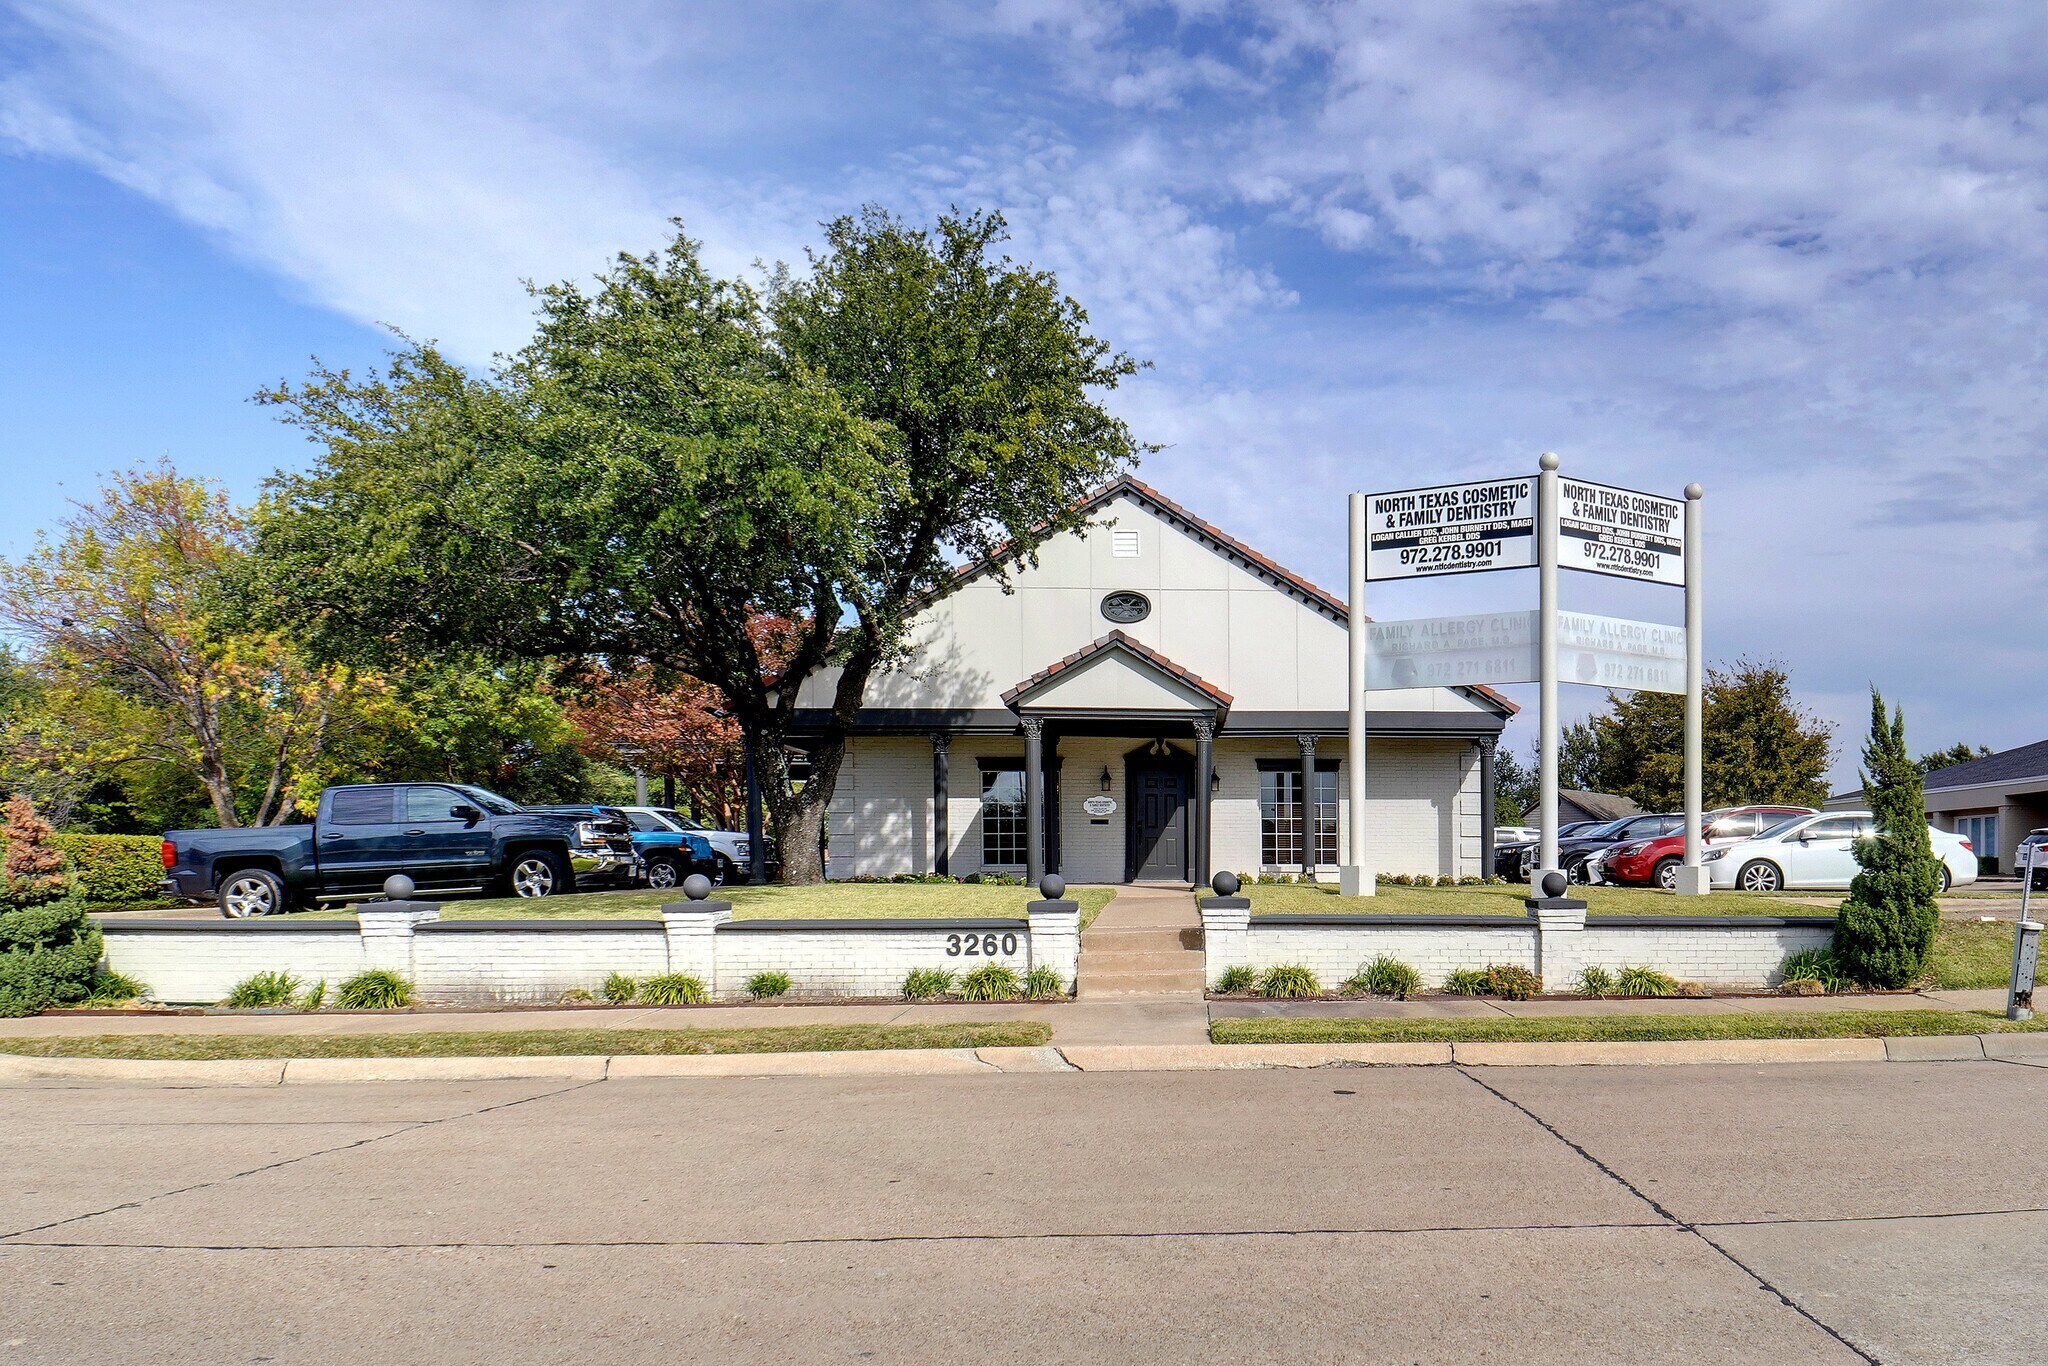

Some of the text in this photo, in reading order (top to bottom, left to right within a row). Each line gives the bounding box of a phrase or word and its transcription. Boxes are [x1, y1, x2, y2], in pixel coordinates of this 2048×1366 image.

[1375, 483, 1528, 514] NORTH TEXAS COSMETIC
[1564, 483, 1678, 519] NORTH TEXAS COSMETIC
[1386, 501, 1516, 528] & FAMILY DENTISTRY
[1561, 519, 1579, 529] LOGAN
[1573, 502, 1670, 533] & FAMILY DENTISTRY
[1372, 519, 1532, 541] LOGAN CALLIER DDS, JOHN BURNETT DDS, MAGD
[1419, 532, 1480, 545] GREG KERBEL DDS
[1599, 534, 1613, 542] GREG
[1401, 540, 1501, 564] 972.278.9901
[1584, 542, 1660, 568] 972.278.9901
[1370, 624, 1413, 640] FAMILY
[1421, 619, 1484, 637] ALLERGY
[1558, 616, 1683, 645] FAMILY ALLERGY CLINIC
[1392, 642, 1438, 651] RICHARD
[1576, 636, 1613, 649] RICHARD
[1428, 658, 1515, 677] 972 271 6811
[1605, 663, 1669, 682] 972 271 6811
[946, 933, 1017, 956] 3260
